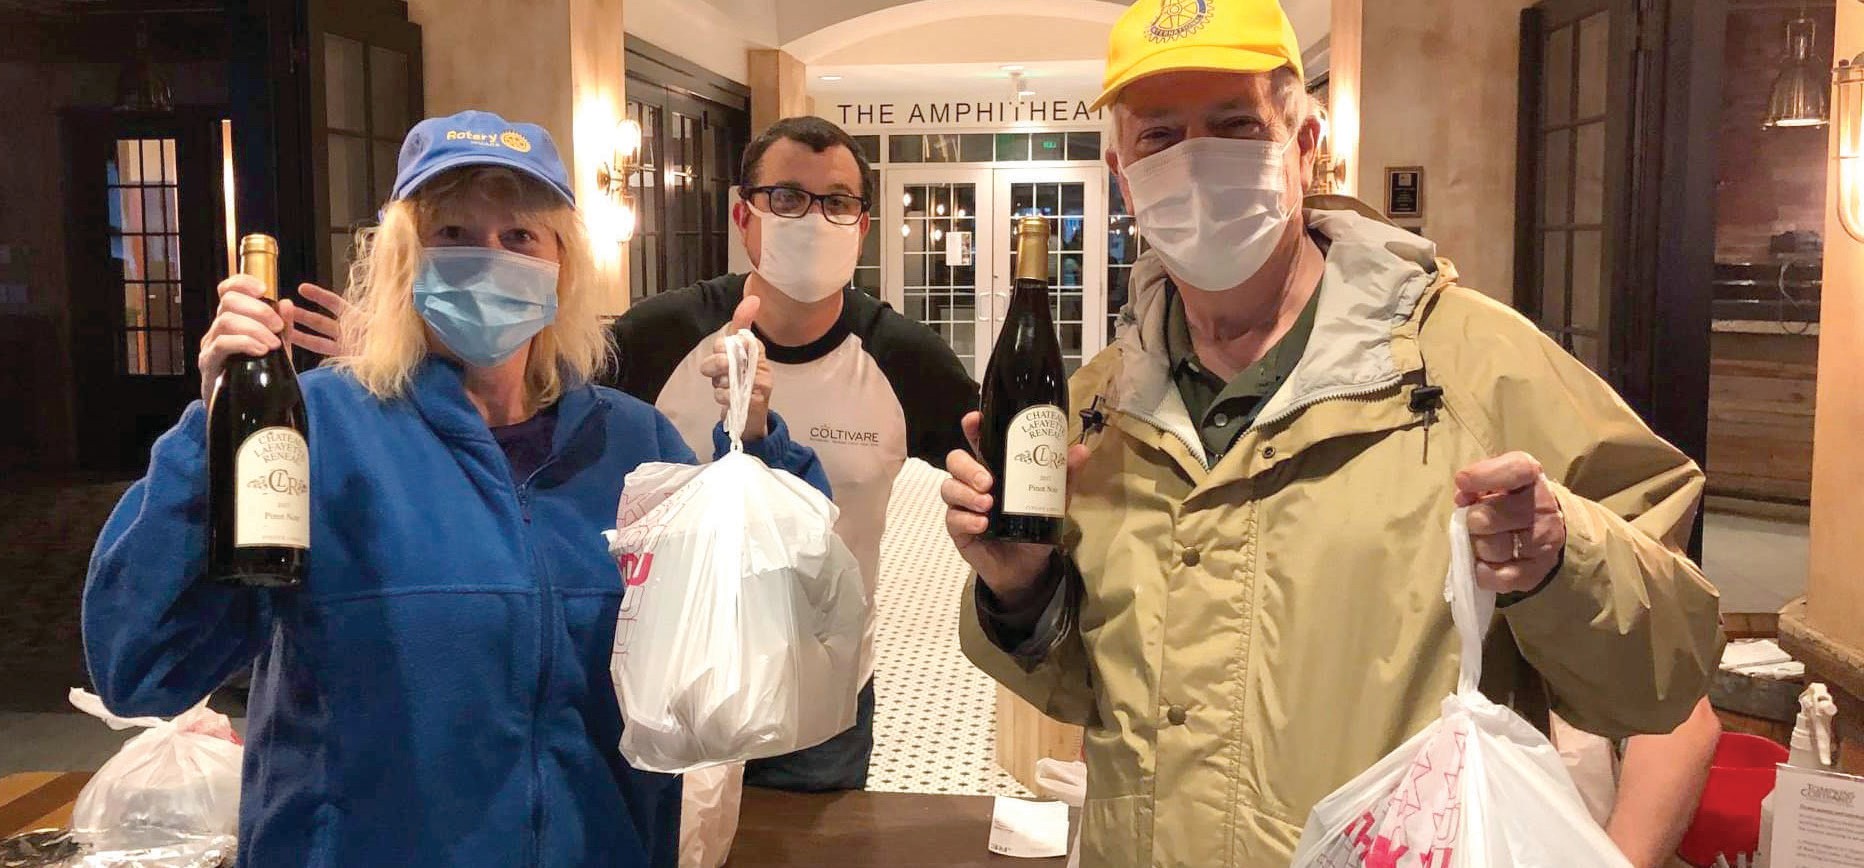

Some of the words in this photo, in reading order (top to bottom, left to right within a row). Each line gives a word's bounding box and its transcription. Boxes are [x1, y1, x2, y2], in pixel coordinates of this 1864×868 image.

[837, 103, 896, 125] THE
[446, 129, 498, 144] Rotary
[809, 426, 880, 443] COLTIVARE
